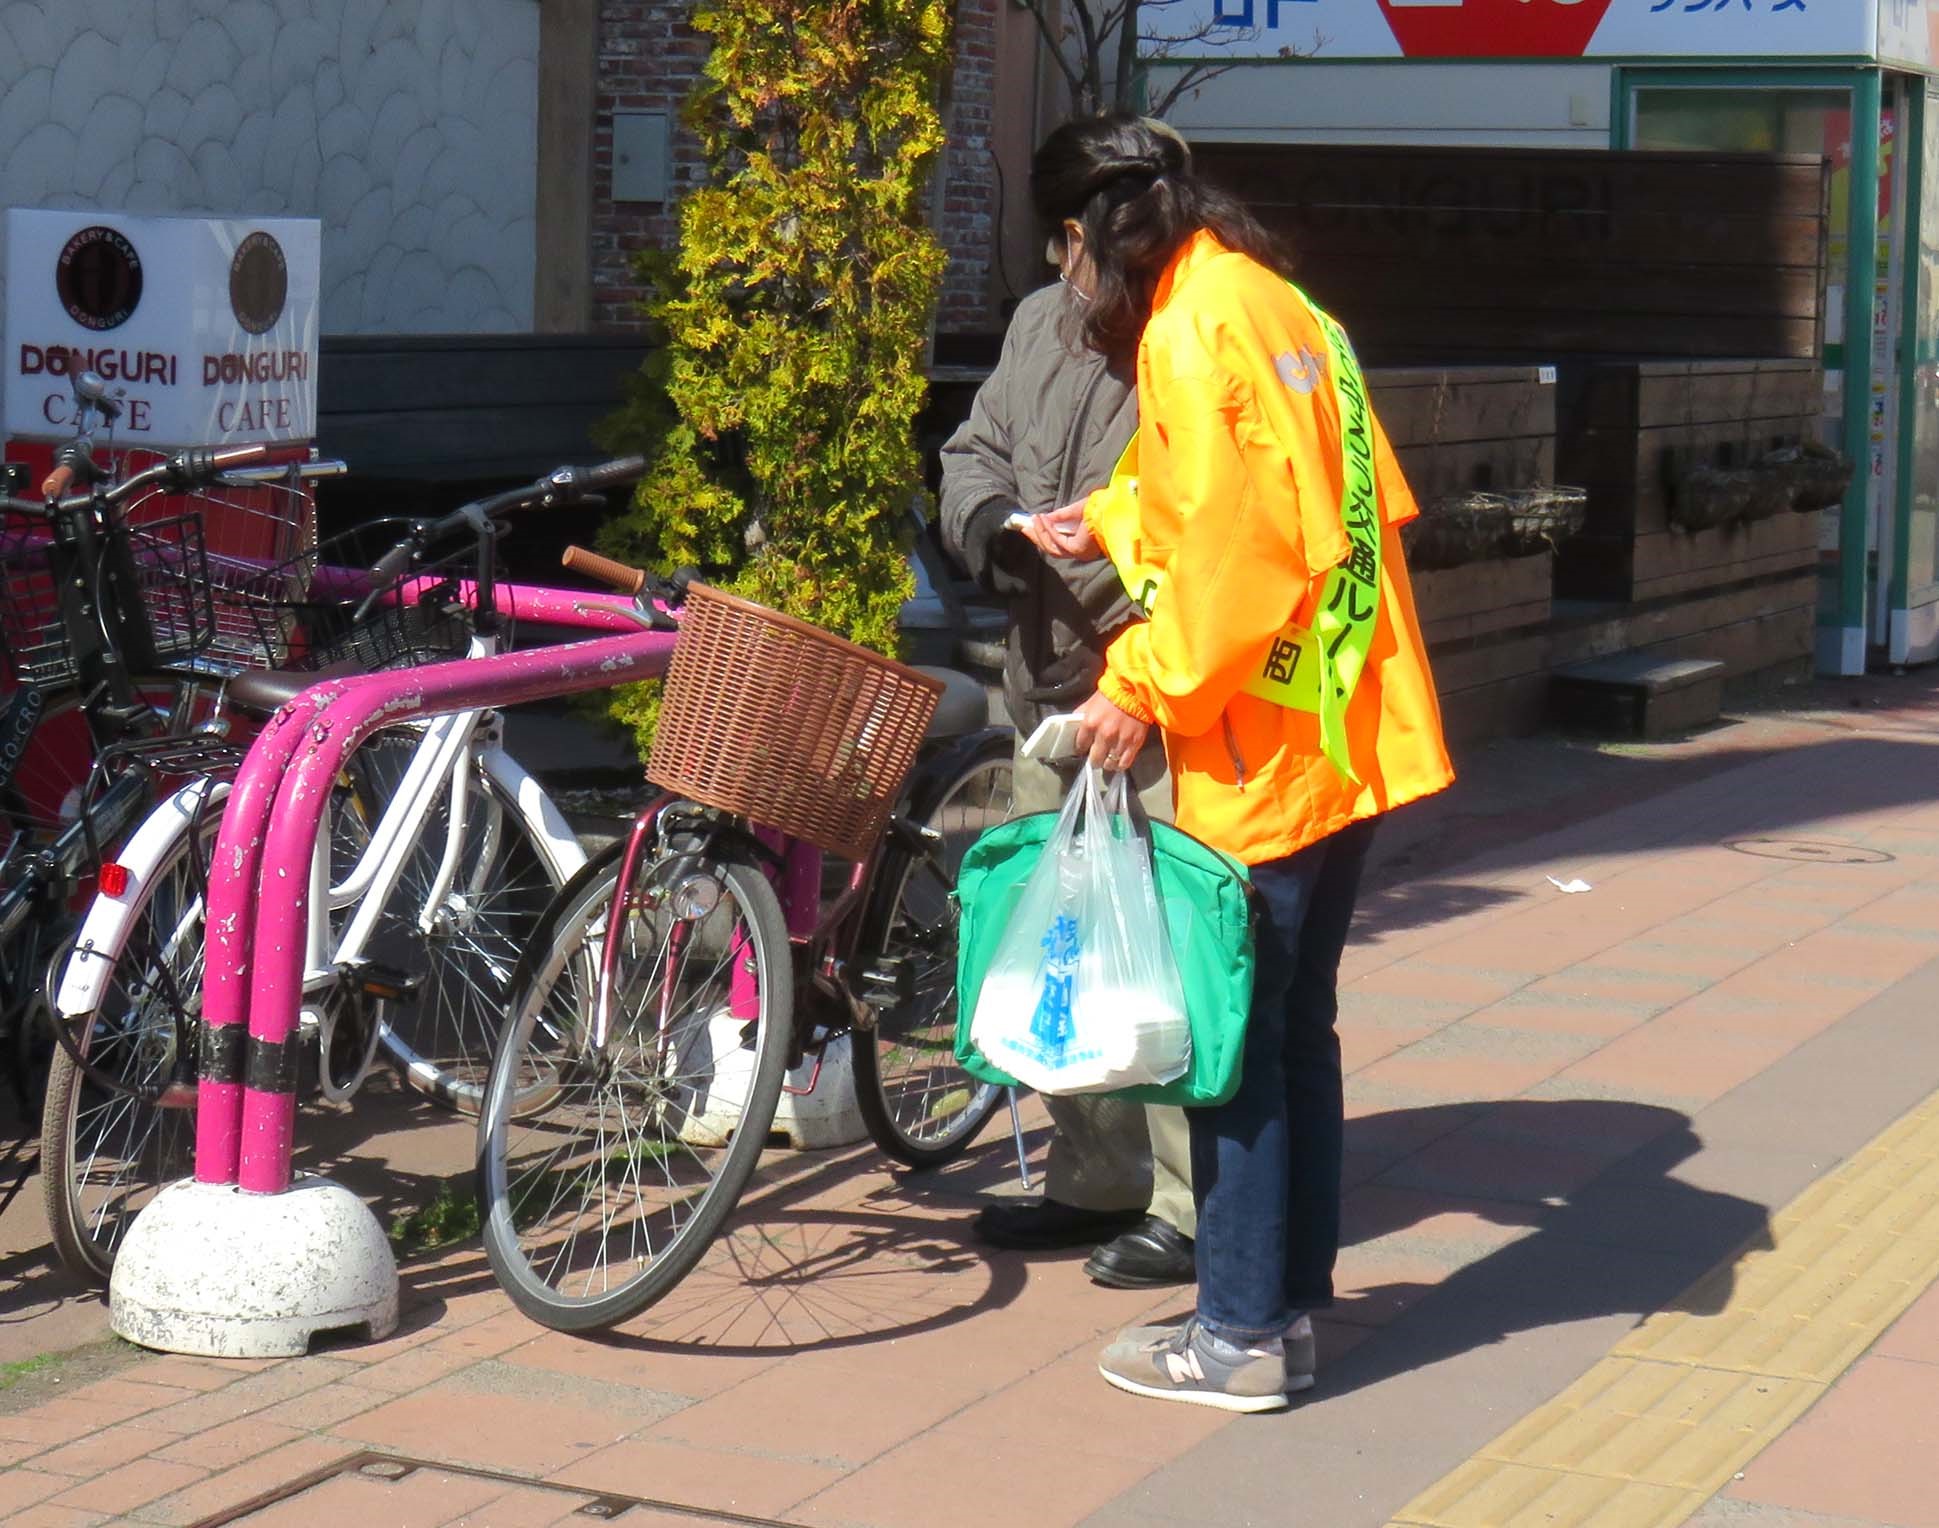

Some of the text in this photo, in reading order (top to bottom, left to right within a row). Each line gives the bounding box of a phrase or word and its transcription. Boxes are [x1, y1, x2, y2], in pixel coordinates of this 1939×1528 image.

[203, 352, 308, 387] DONGURI
[218, 399, 291, 433] CAFE
[1165, 1348, 1205, 1384] N
